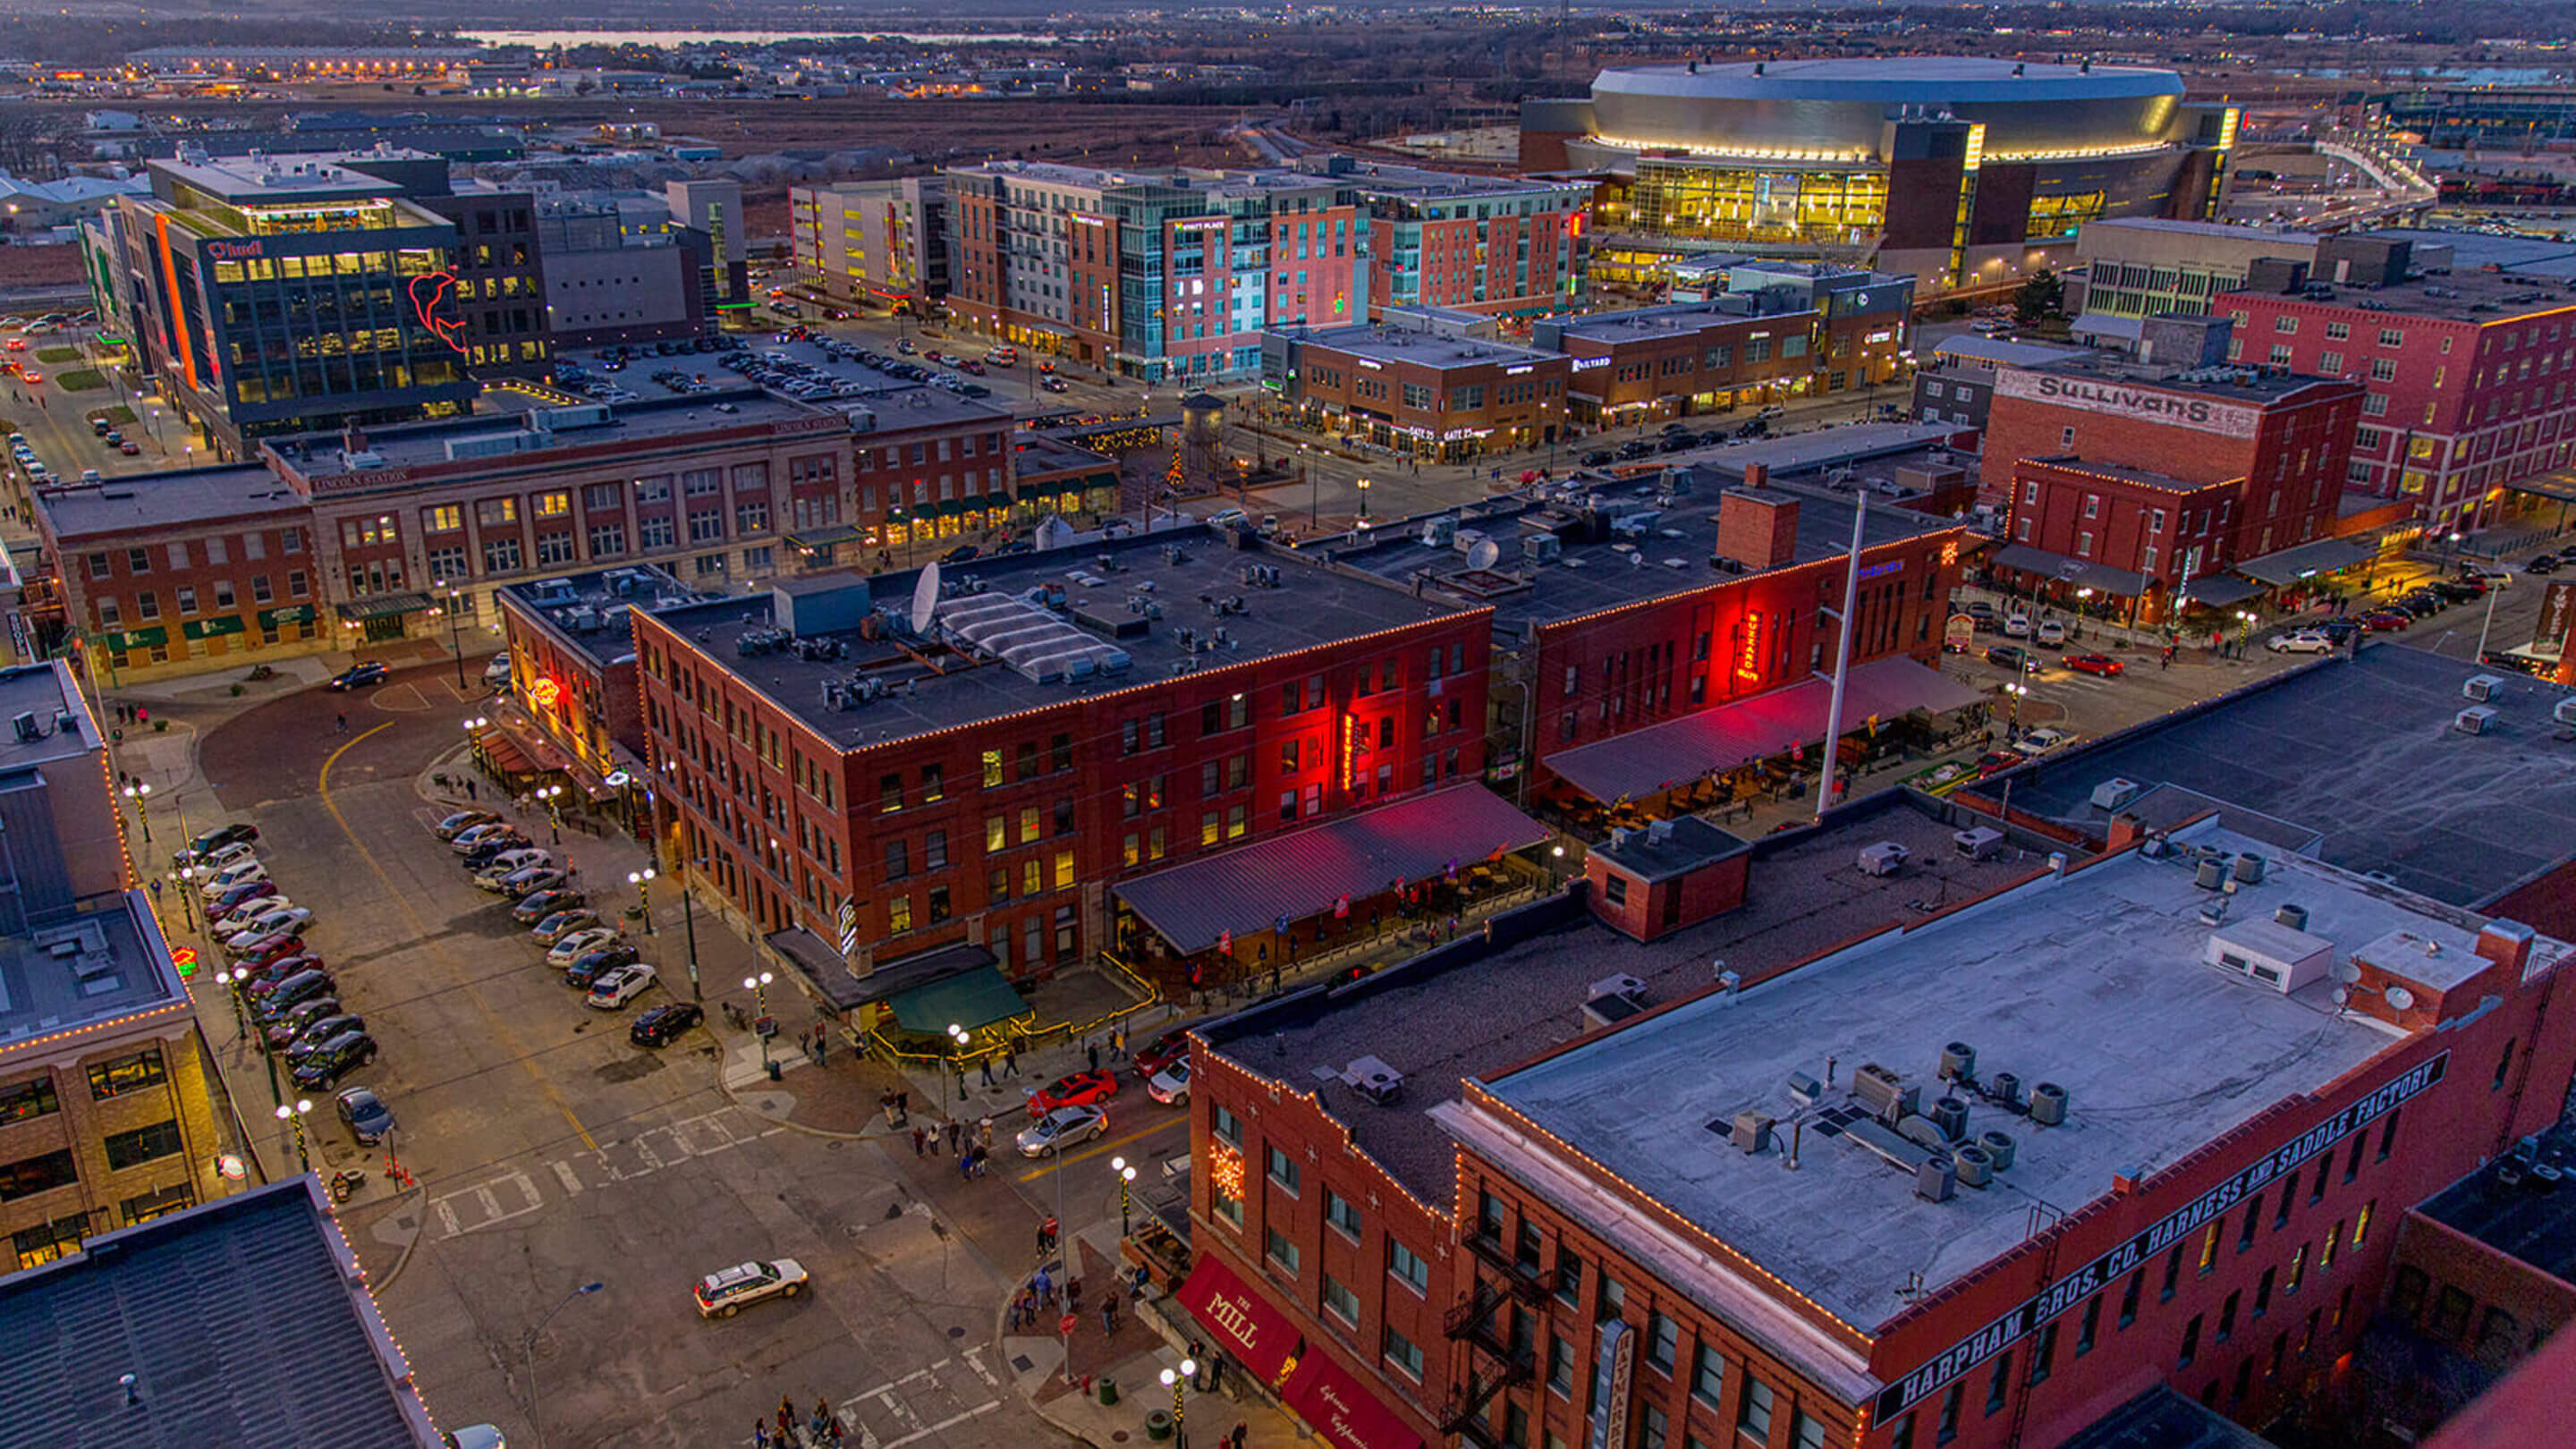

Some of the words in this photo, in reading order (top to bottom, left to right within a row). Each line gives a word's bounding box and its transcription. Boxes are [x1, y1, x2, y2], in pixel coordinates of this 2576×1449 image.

[227, 240, 263, 258] hudl
[1572, 356, 1611, 372] RAILYARD
[314, 476, 362, 490] LINCOLN
[364, 471, 407, 485] STATION
[1901, 1310, 2025, 1407] HARPHAM
[2034, 1267, 2099, 1325] BROS.
[2106, 1241, 2140, 1278] CO.
[2146, 1176, 2243, 1254] HARNESS
[2247, 1157, 2276, 1190] AND
[2277, 1111, 2351, 1173] SADDLE
[2354, 1062, 2435, 1125] FACTORY
[1236, 1295, 1252, 1311] THE
[1206, 1291, 1258, 1350] MILL
